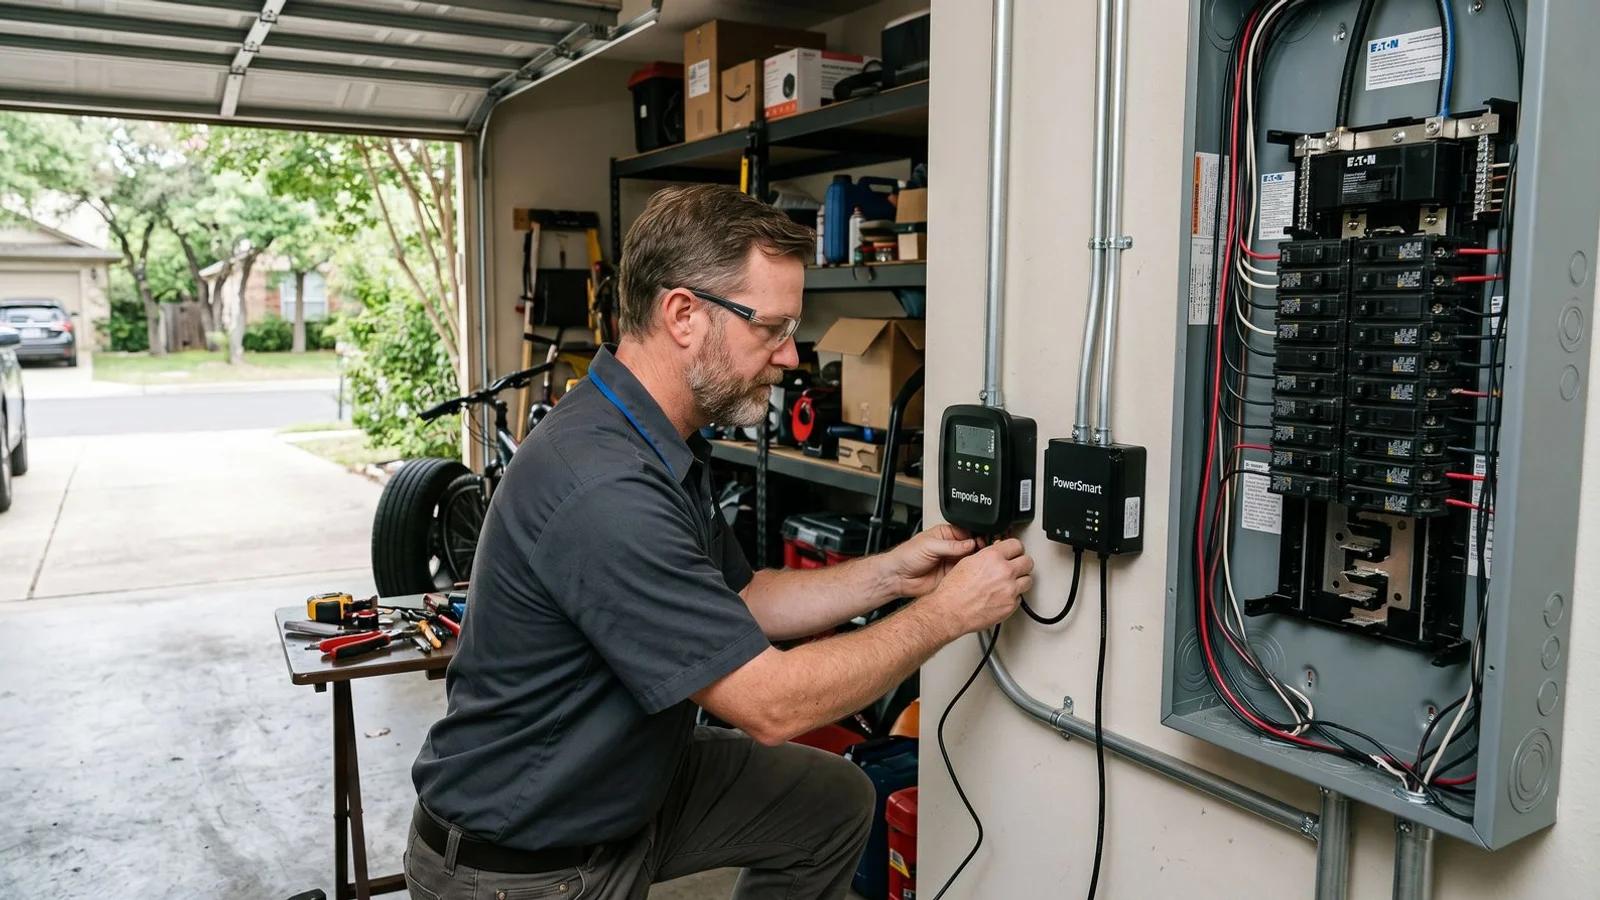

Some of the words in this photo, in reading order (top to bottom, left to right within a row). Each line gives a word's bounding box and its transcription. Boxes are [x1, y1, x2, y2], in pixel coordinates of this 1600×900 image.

[1053, 477, 1102, 494] PowerSmart
[951, 488, 978, 503] Emporia
[980, 494, 992, 506] Pro
